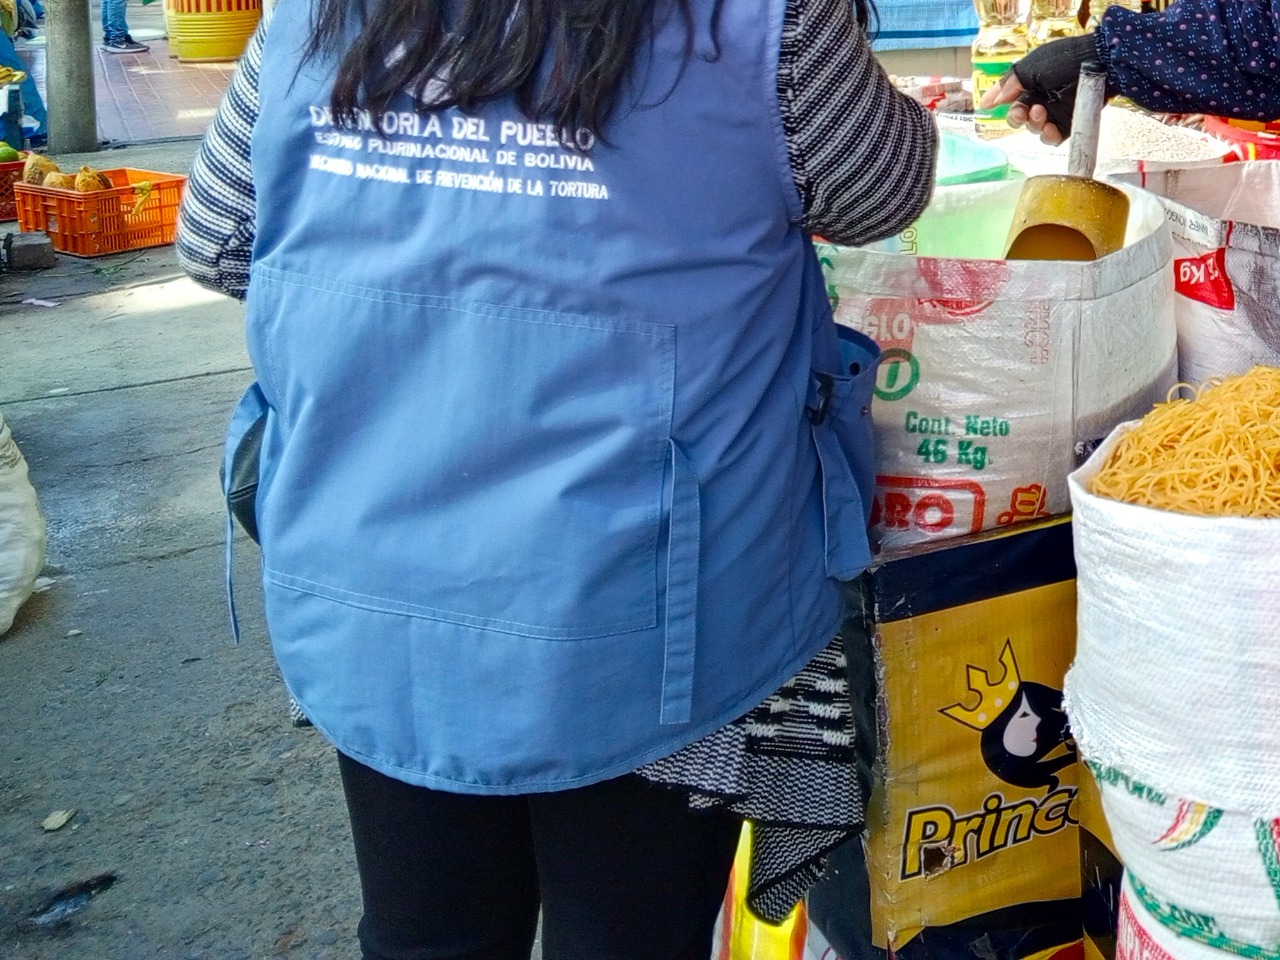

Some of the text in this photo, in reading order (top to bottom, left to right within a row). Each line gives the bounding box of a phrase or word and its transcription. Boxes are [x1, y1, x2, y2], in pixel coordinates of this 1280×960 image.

[452, 117, 489, 141] DEL
[368, 138, 489, 163] PLURINACIONAL
[496, 151, 517, 166] DE
[524, 153, 594, 172] BOLIVIA
[416, 169, 432, 184] DE
[507, 179, 522, 194] DE
[526, 180, 543, 195] LA
[550, 181, 609, 200] TORTURA
[965, 414, 1011, 437] Neto
[917, 438, 948, 464] 46
